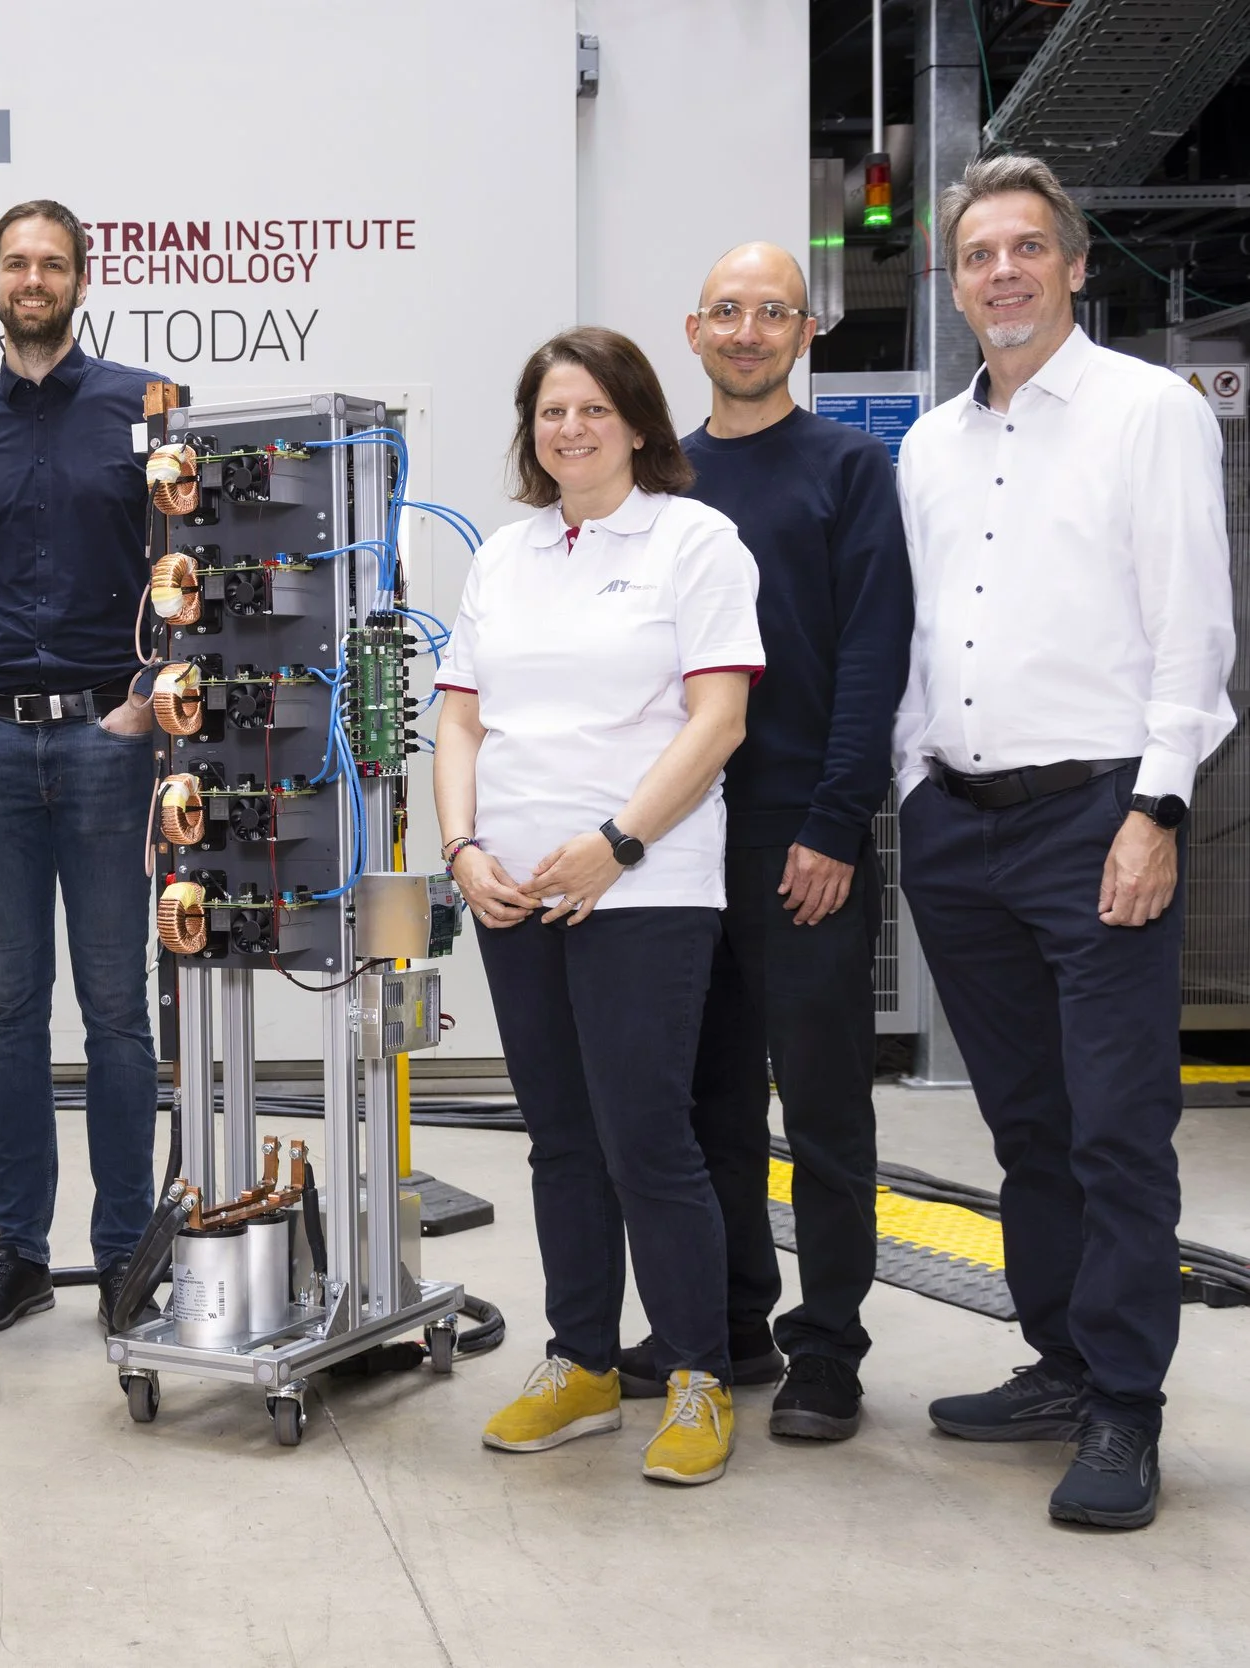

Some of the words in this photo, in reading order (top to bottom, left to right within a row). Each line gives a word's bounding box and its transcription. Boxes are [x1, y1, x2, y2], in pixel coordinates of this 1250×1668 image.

[225, 220, 416, 250] INSTITUTE
[86, 253, 318, 285] TECHNOLOGY
[129, 309, 319, 363] TODAY
[596, 579, 631, 596] AIT
